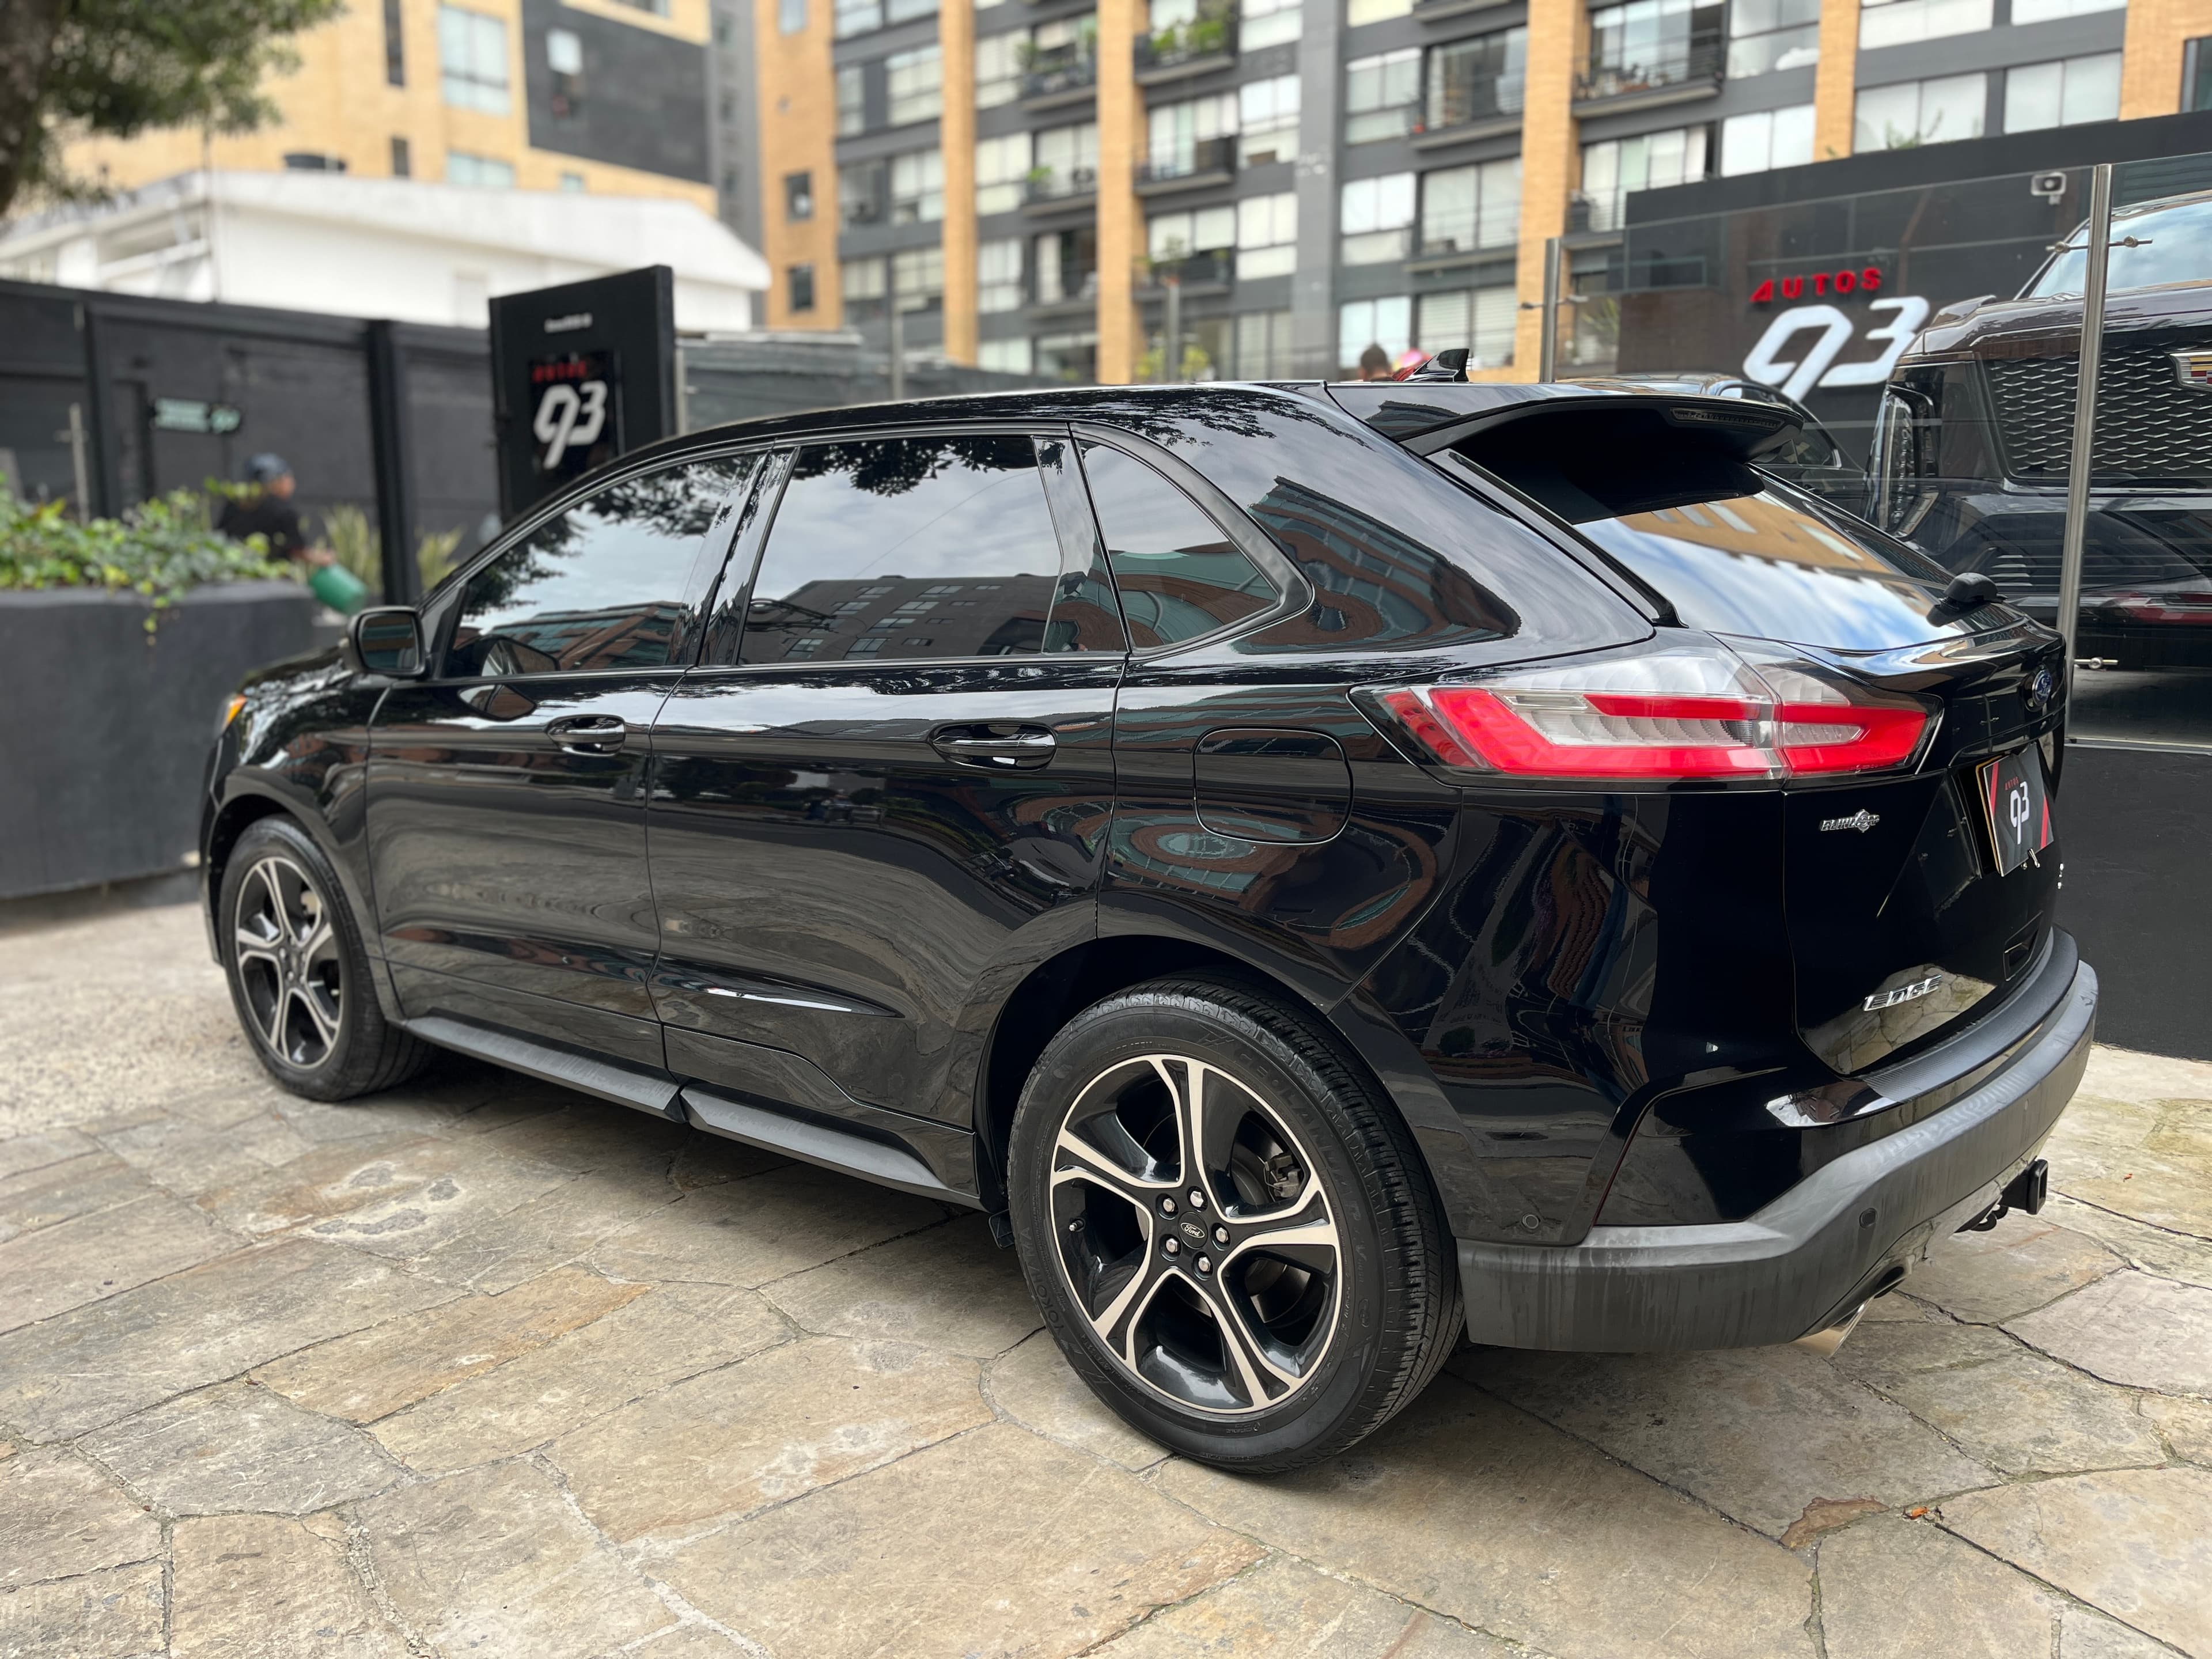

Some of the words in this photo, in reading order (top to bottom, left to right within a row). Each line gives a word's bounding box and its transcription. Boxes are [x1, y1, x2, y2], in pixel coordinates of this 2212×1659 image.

[1749, 268, 1881, 303] AUTOS
[1743, 296, 1930, 403] 93
[533, 380, 608, 469] 93
[2010, 781, 2030, 845] 93
[1863, 975, 1942, 1012] EDGE
[1183, 1224, 1202, 1237] Ford
[1018, 1226, 1066, 1335] YOKOHAMA
